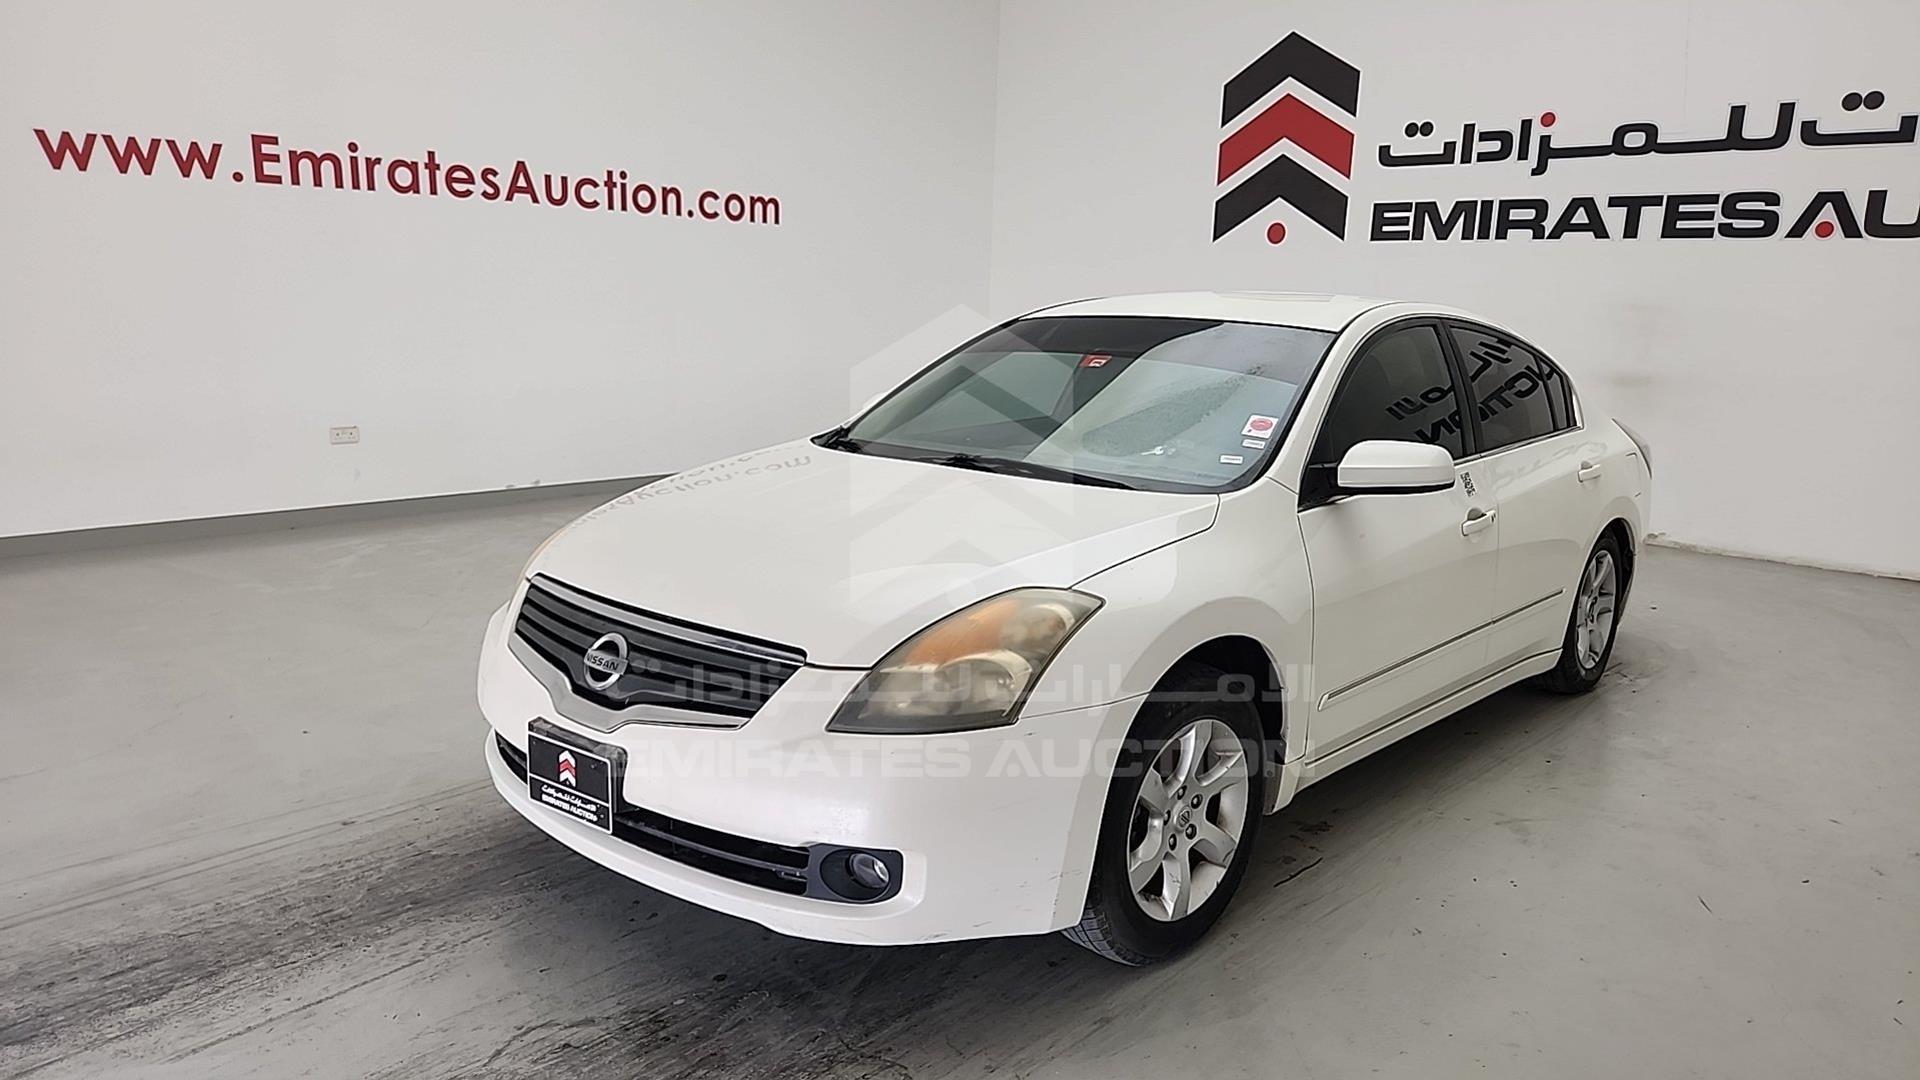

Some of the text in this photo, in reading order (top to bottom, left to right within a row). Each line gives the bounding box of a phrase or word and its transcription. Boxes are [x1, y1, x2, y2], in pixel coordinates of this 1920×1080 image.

[1378, 101, 1797, 177] للمزادات
[33, 128, 781, 225] www.EmiratesAuction.com
[1370, 191, 1781, 241] EMIRATES
[586, 652, 619, 671] NISSAN
